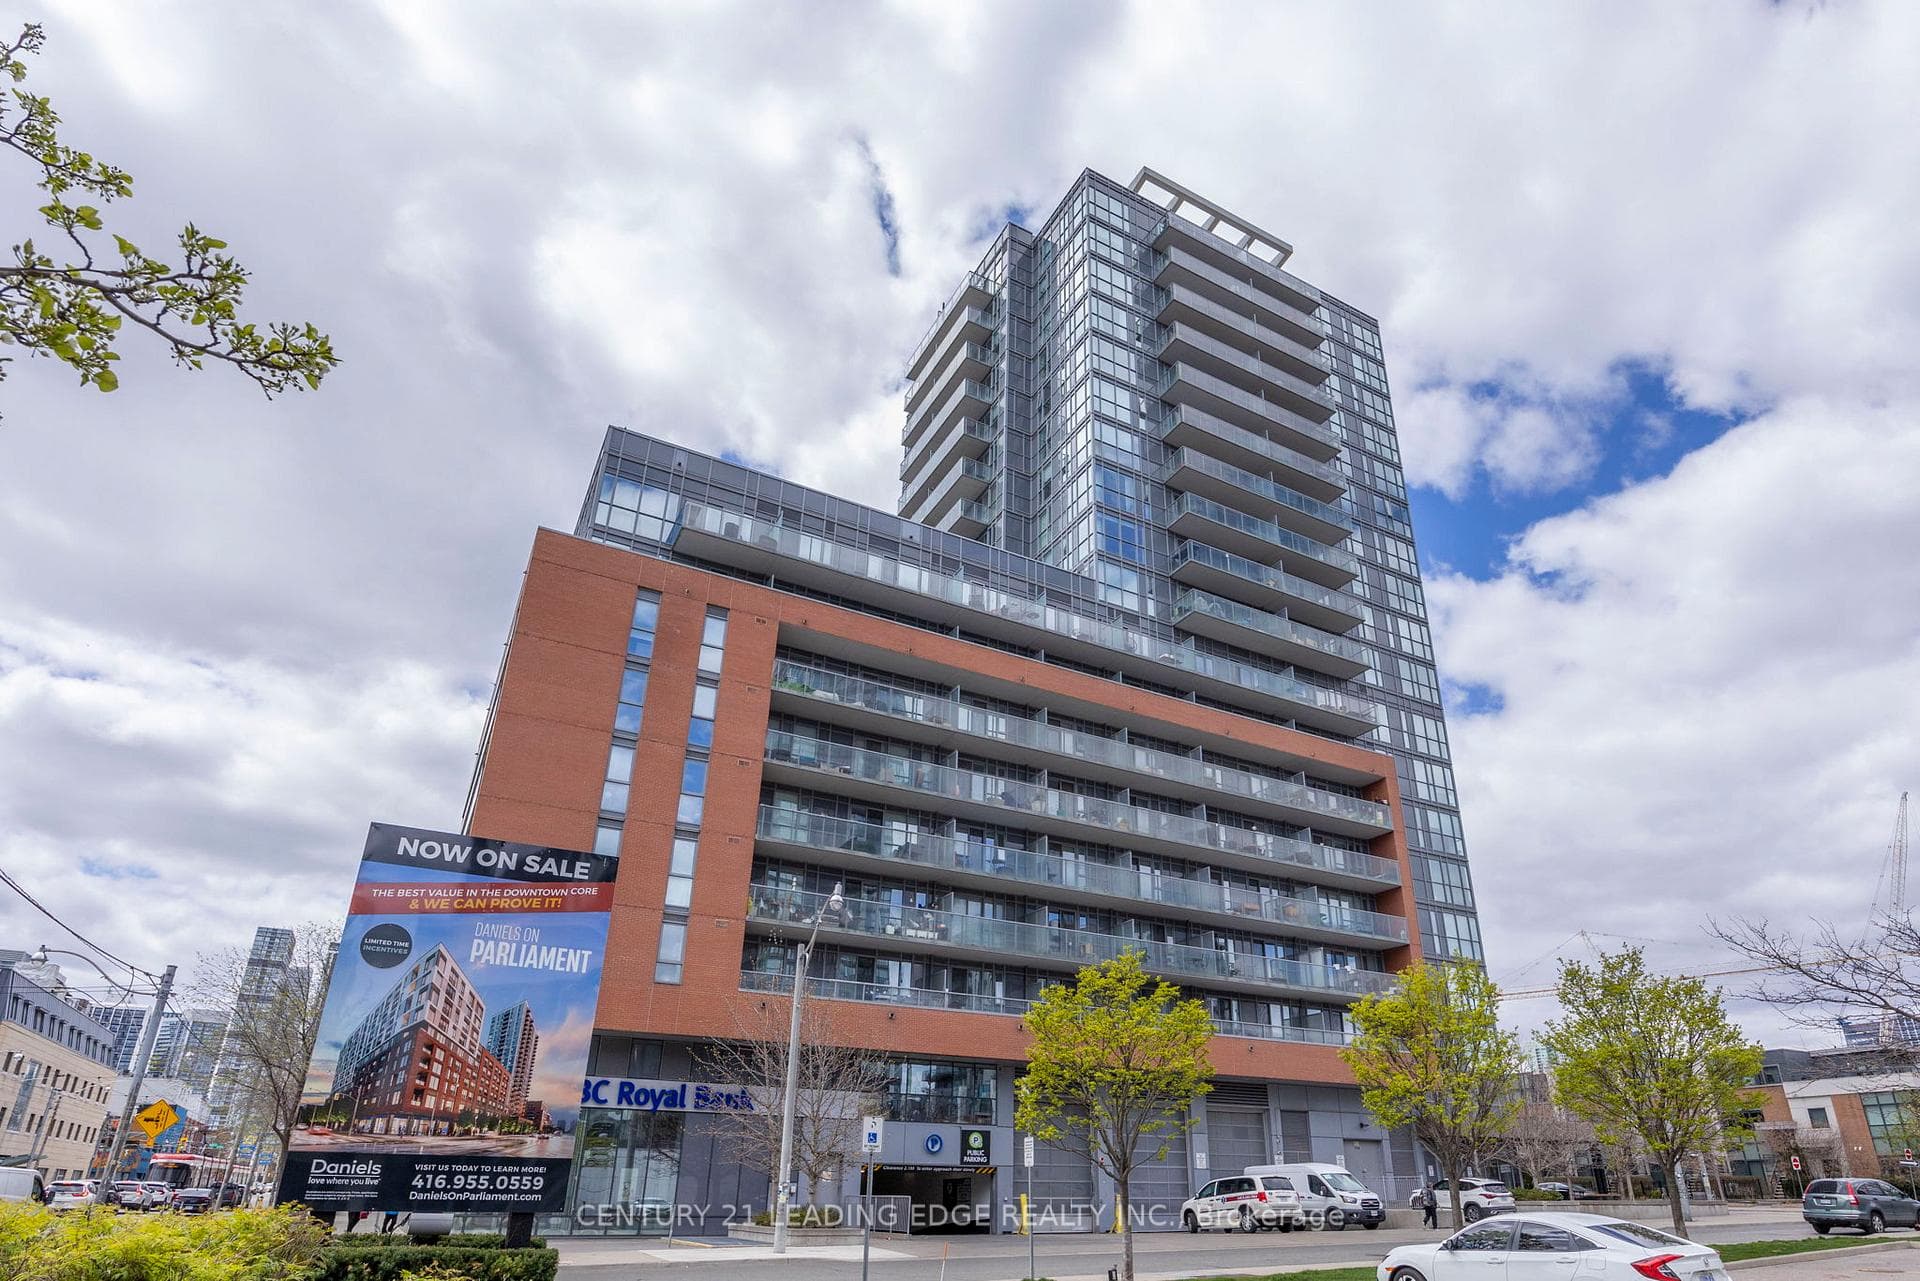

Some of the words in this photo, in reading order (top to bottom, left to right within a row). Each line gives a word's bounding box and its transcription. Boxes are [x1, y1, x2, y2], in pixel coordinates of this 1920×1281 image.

[397, 837, 472, 864] NOW
[476, 850, 517, 871] ON
[523, 856, 591, 880] SALE
[372, 889, 394, 897] THE
[397, 889, 426, 897] BEST
[428, 889, 464, 897] VALUE
[466, 889, 478, 897] IN
[503, 888, 568, 896] DOWNTOWN
[570, 887, 598, 895] CORE
[409, 898, 420, 909] &
[424, 898, 450, 909] WE
[453, 898, 487, 909] CAN
[490, 898, 542, 909] PROVE
[544, 897, 562, 909] IT!
[475, 922, 521, 941] DANIELS
[523, 928, 540, 943] ON
[362, 944, 408, 955] INCENTIVES
[364, 938, 393, 946] LIMITED
[393, 940, 409, 948] TIME
[469, 939, 592, 974] PARLIAMENT
[617, 1081, 687, 1113] Royal
[310, 1158, 382, 1174] Daniels
[307, 1176, 325, 1184] love
[326, 1177, 349, 1185] where
[350, 1178, 364, 1186] you
[411, 1174, 544, 1190] 416.955.0559
[409, 1191, 542, 1201] DanielsOnParliament.com
